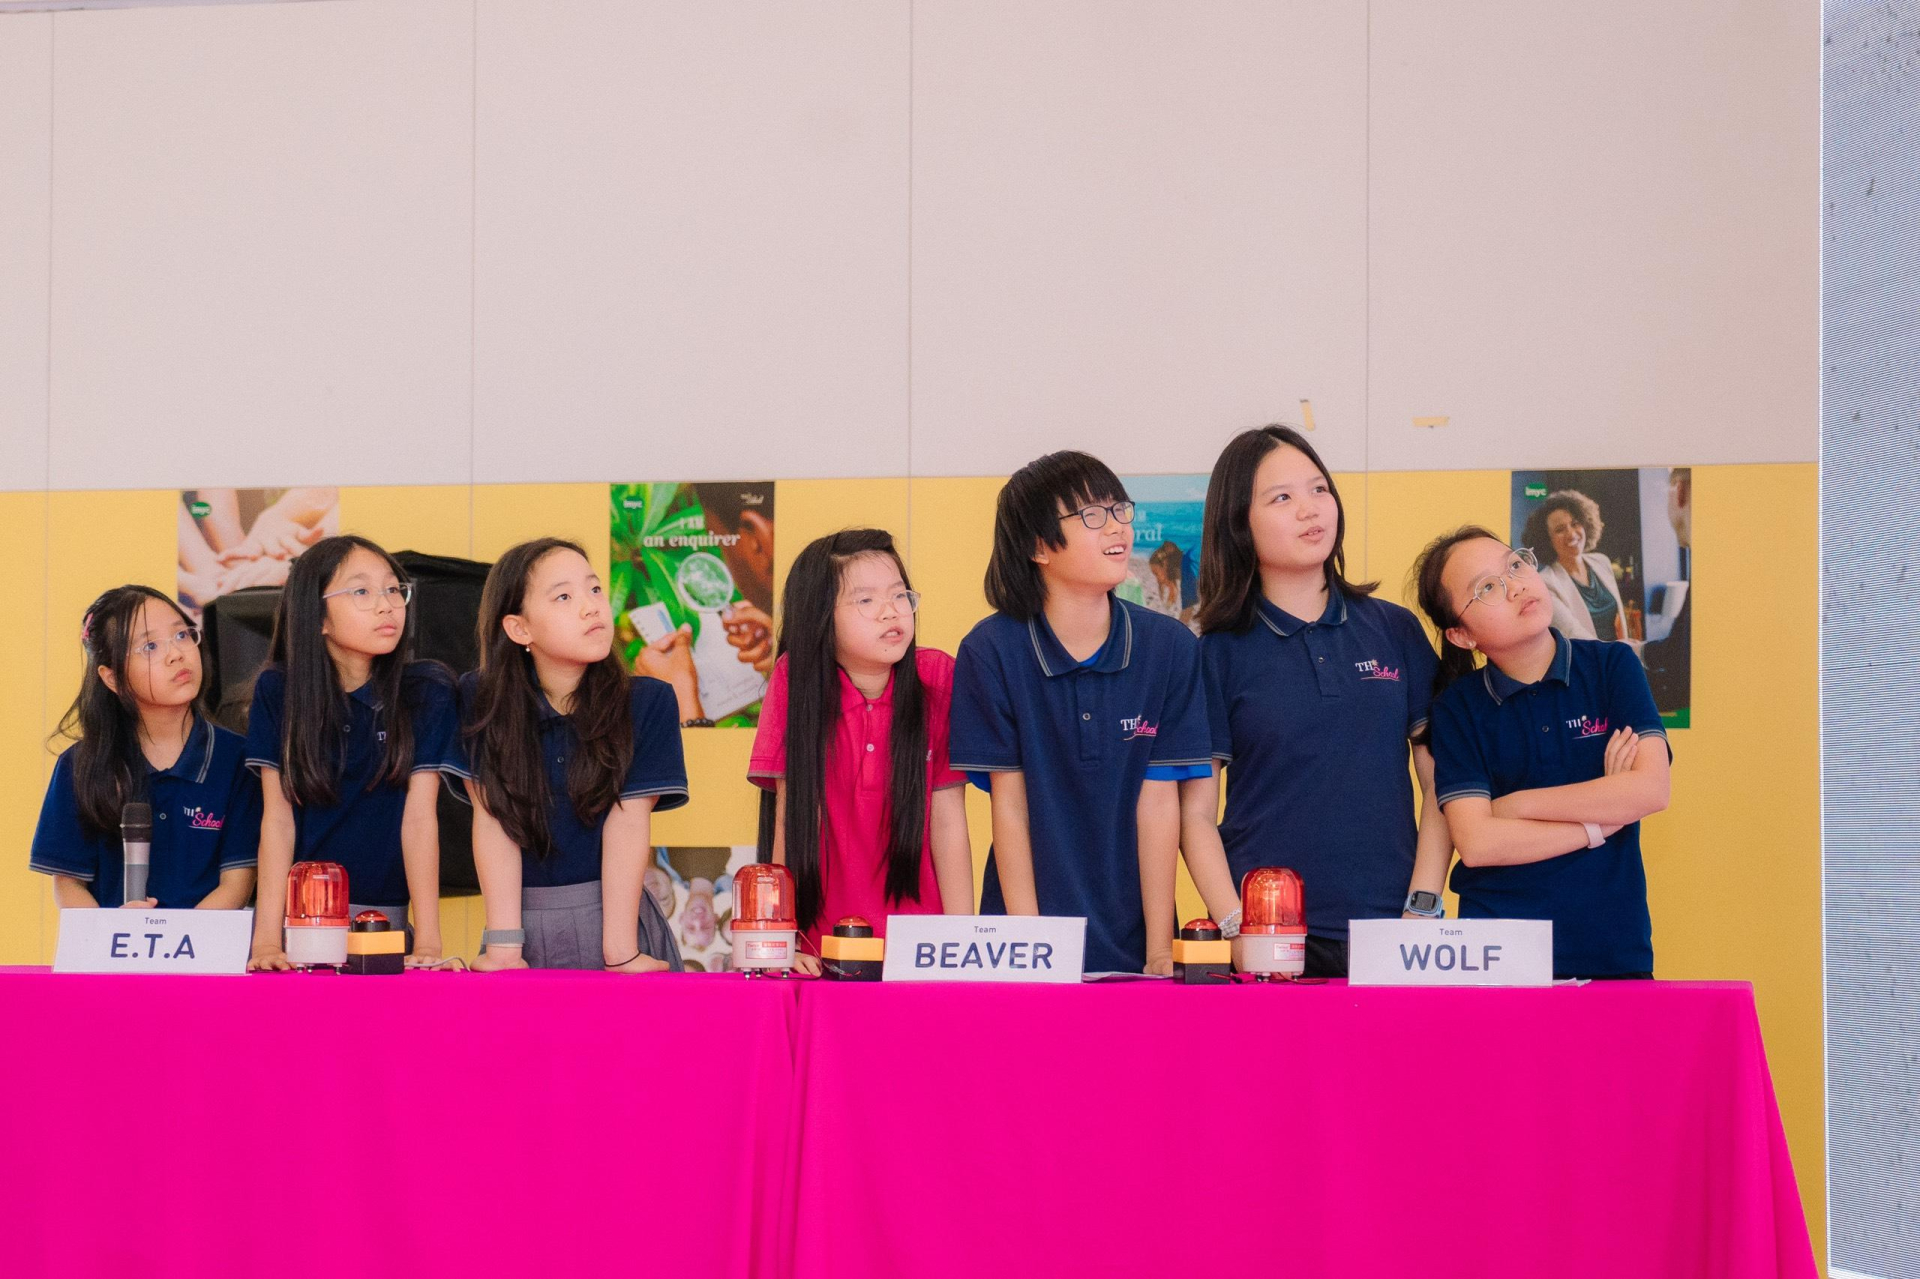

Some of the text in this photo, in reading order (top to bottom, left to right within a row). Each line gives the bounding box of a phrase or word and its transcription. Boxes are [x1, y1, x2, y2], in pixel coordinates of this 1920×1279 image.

[643, 531, 741, 551] an enquirer
[145, 917, 167, 925] Team
[974, 926, 997, 934] Team
[1439, 928, 1463, 936] Team
[110, 932, 195, 959] E.T.A
[915, 941, 1053, 969] BEAVER
[1399, 943, 1502, 971] WOLF
